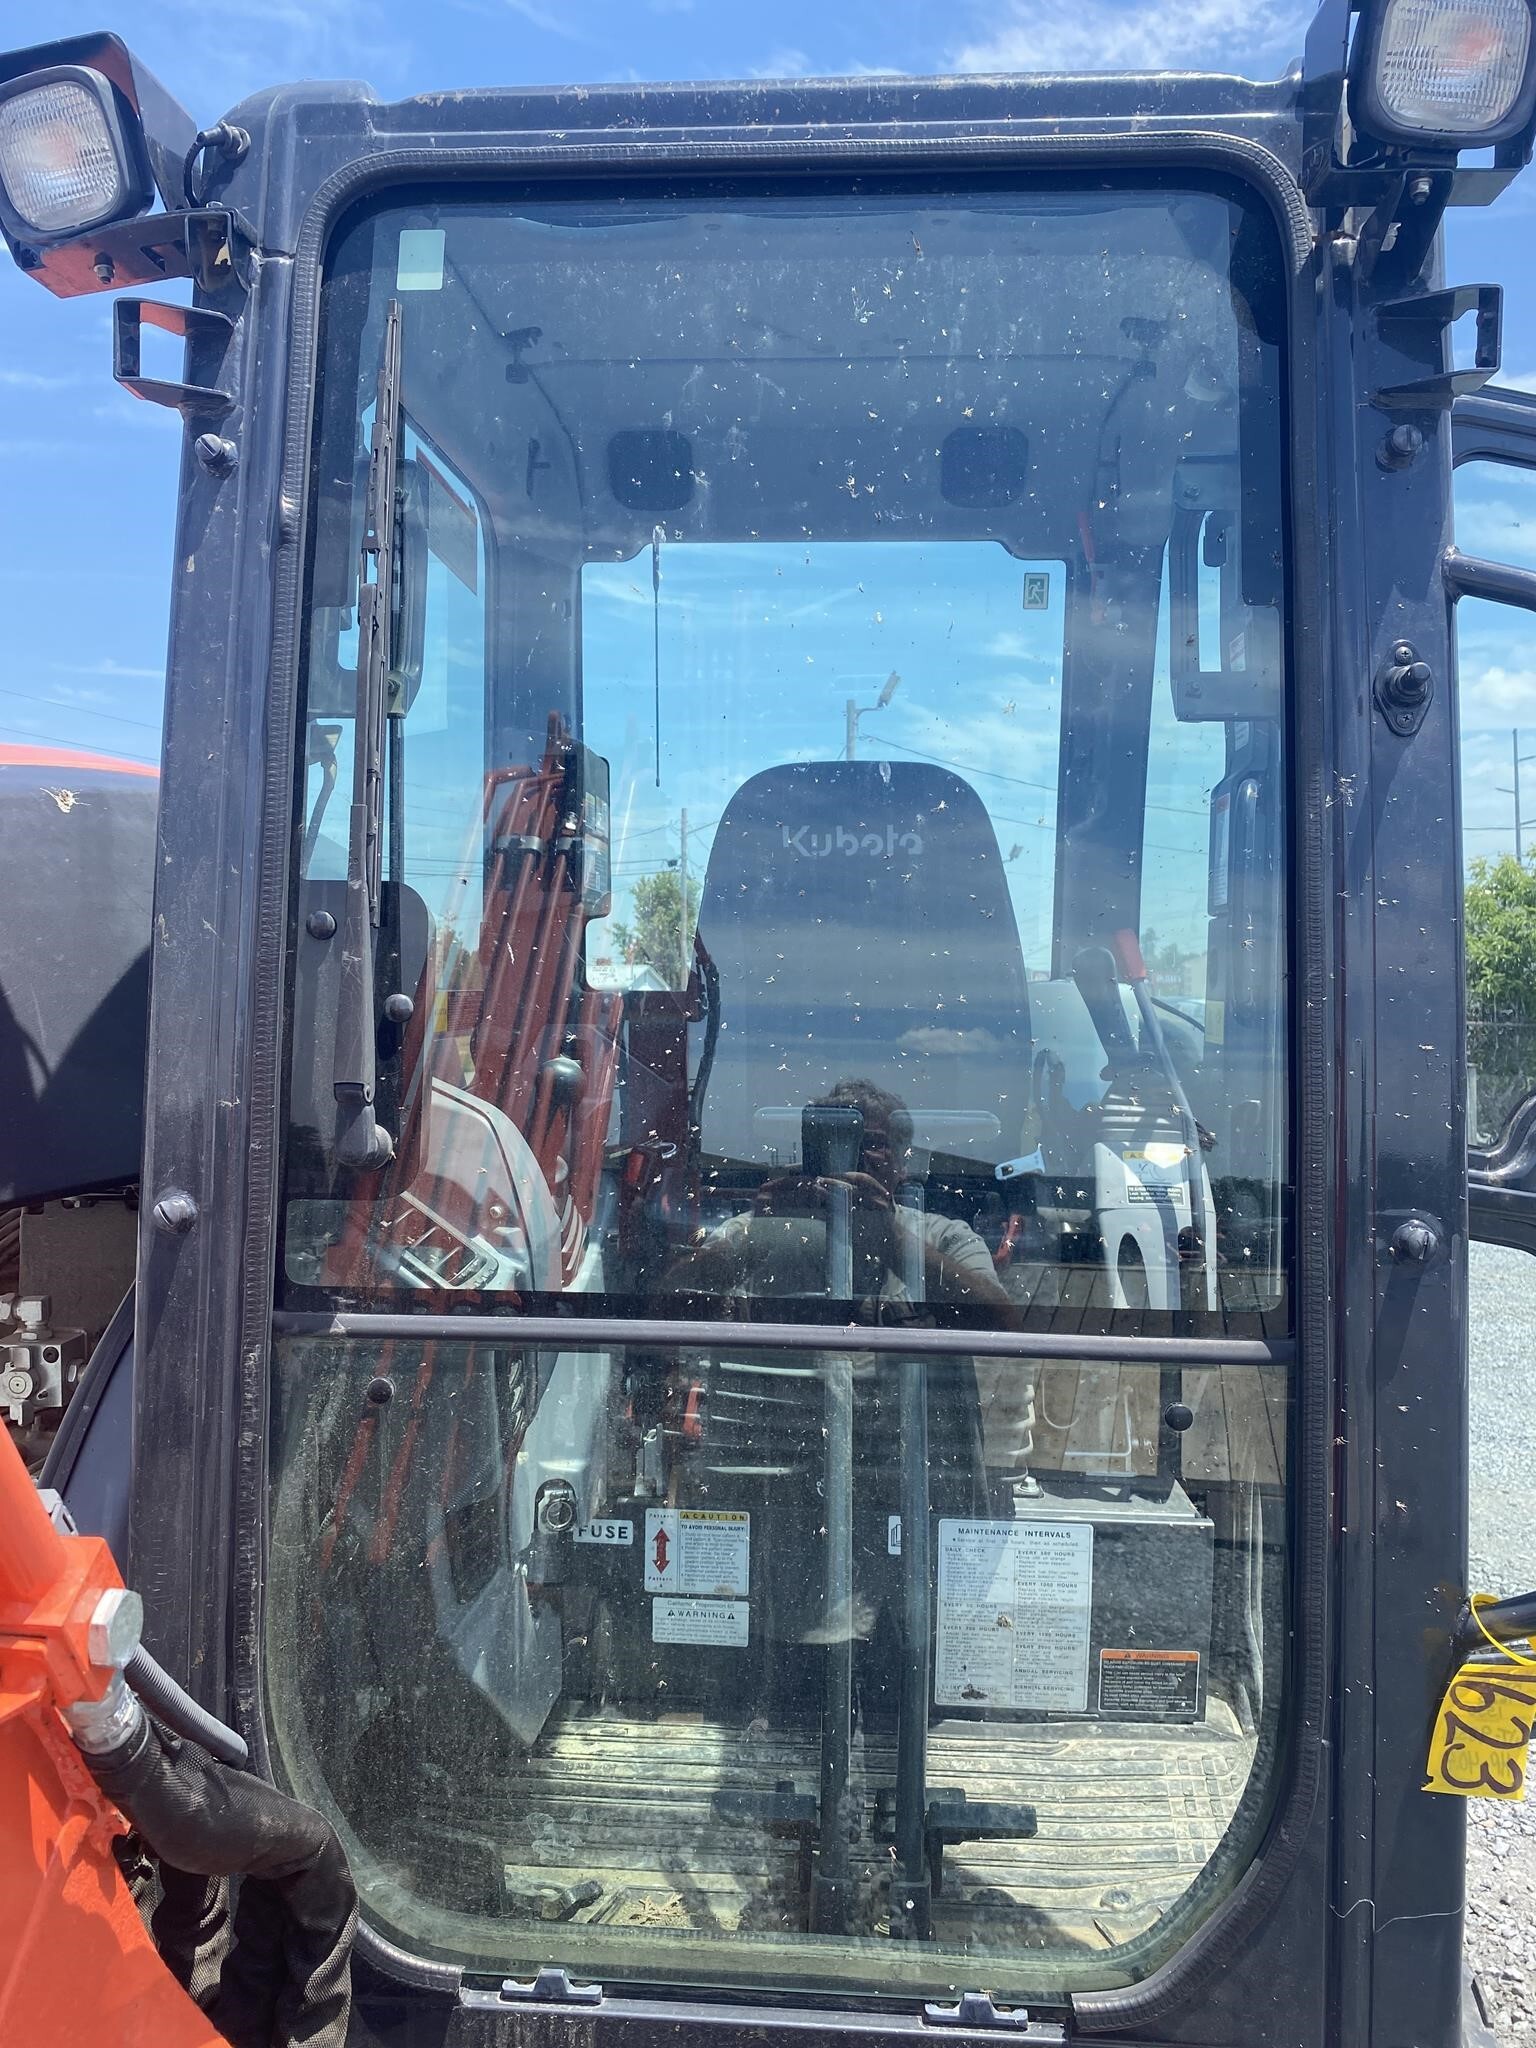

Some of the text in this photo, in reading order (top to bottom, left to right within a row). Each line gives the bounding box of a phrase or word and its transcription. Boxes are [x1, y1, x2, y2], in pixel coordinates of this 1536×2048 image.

[782, 824, 924, 857] Kubota
[578, 1525, 628, 1540] FUSE
[958, 1527, 1072, 1539] MAINTENANCE INTERVALS
[677, 1610, 725, 1619] WARNING
